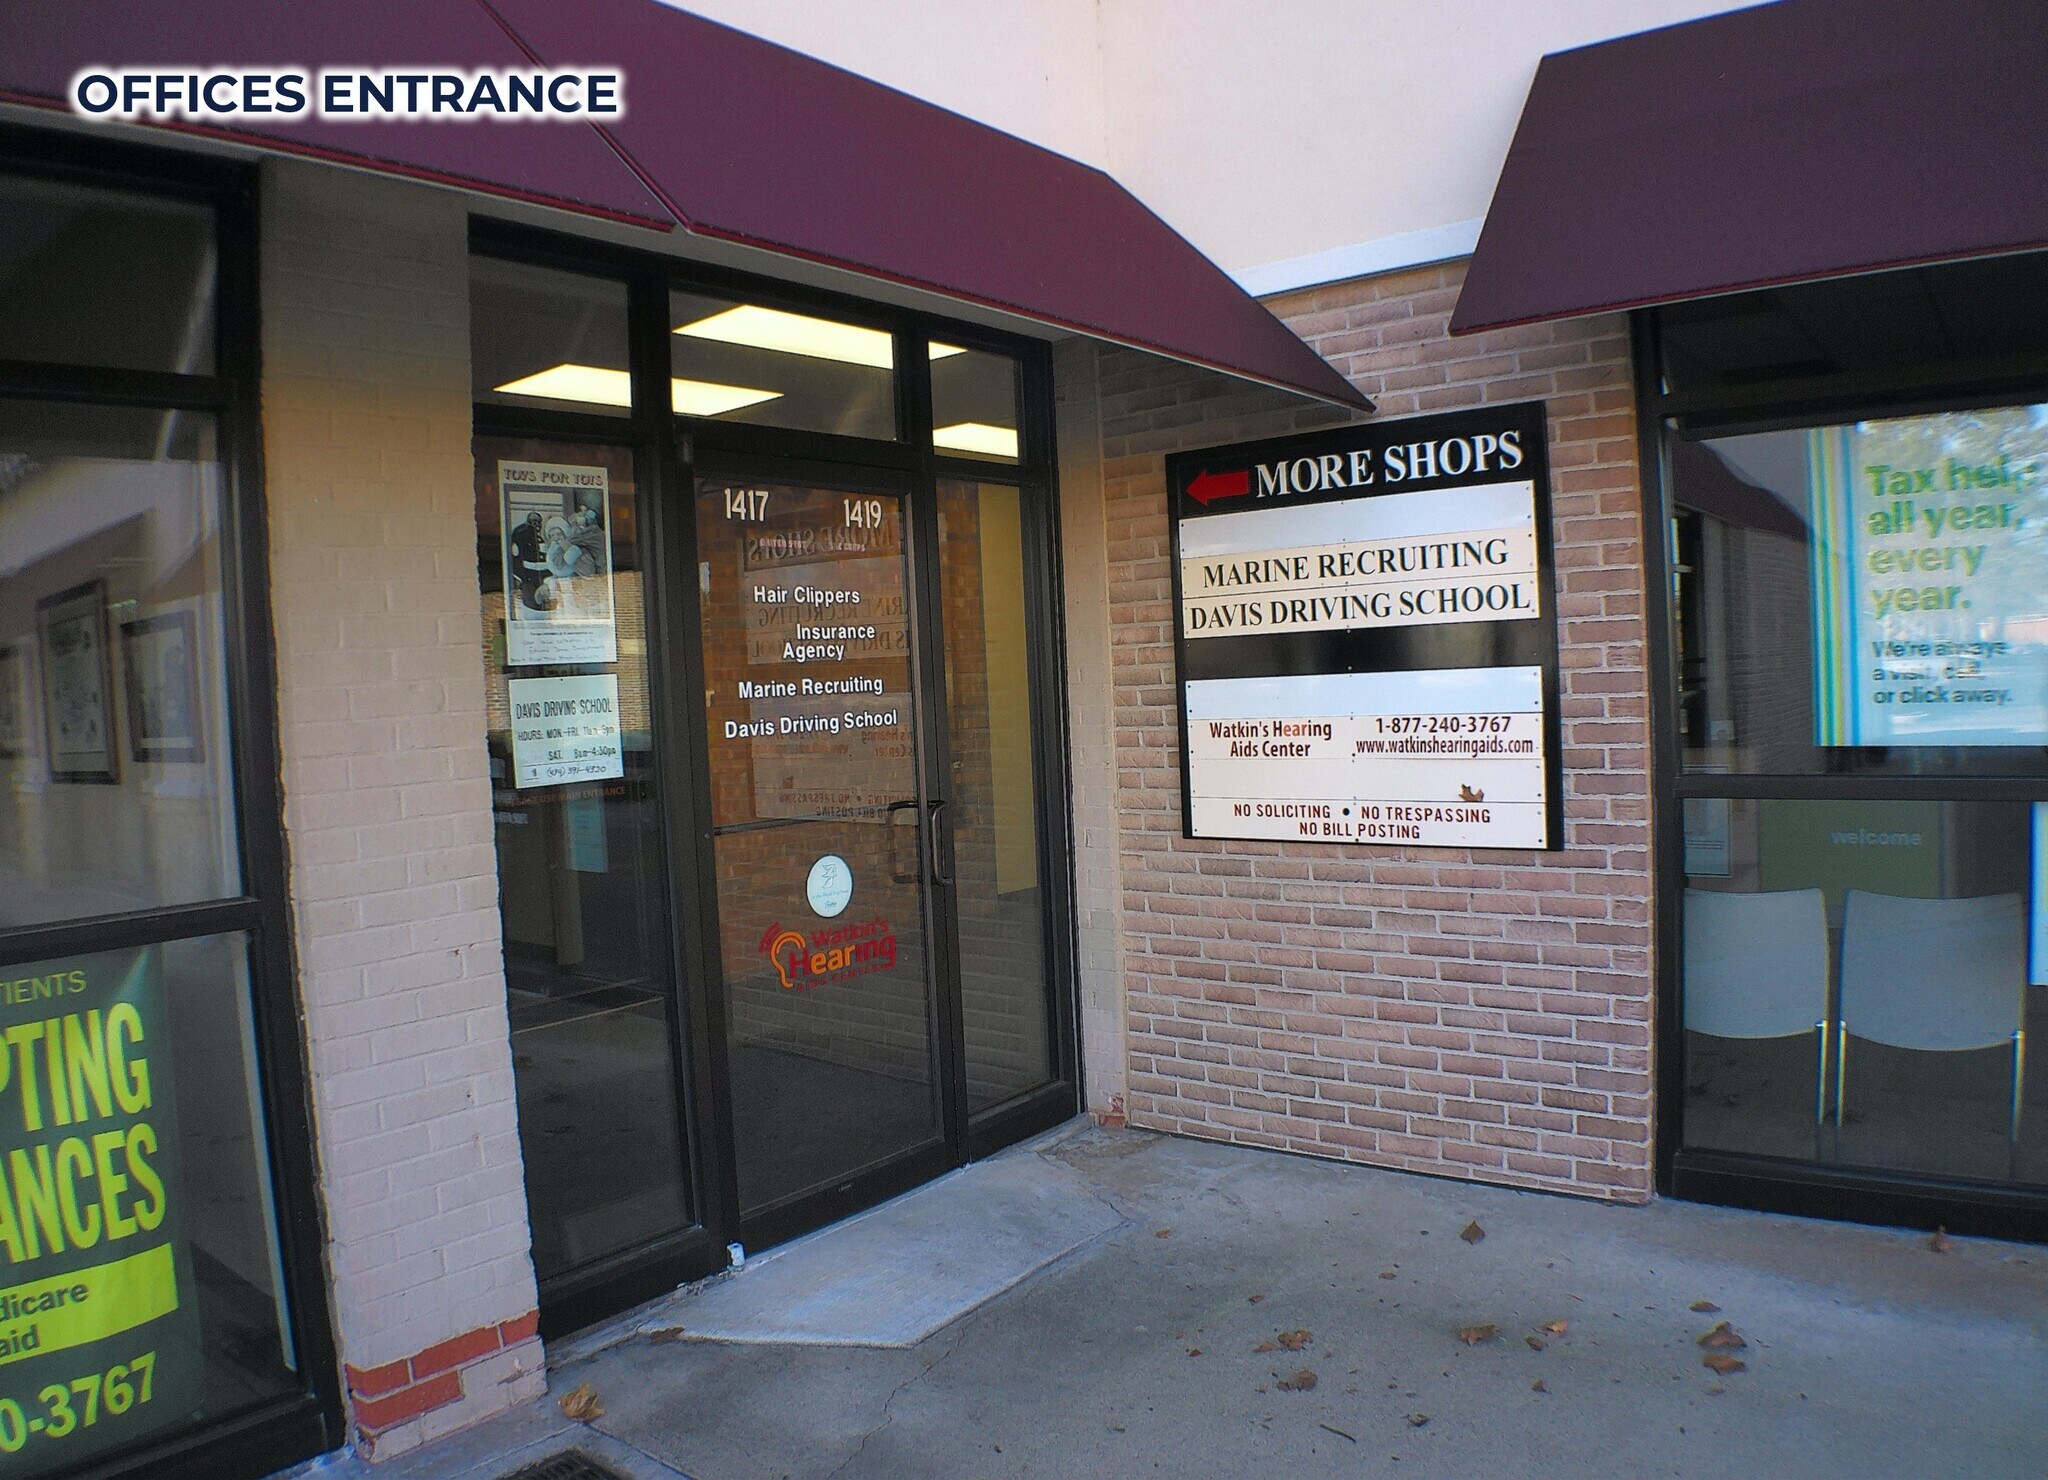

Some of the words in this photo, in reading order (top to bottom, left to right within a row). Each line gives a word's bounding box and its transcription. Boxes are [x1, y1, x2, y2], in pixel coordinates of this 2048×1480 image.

[1255, 450, 1375, 498] MORE
[1383, 430, 1525, 484] SHOPS
[1864, 464, 1937, 496] Tax
[724, 487, 769, 522] 1417
[843, 498, 882, 529] 1419
[1867, 500, 1914, 536] all
[1203, 556, 1310, 589] MARINE
[1317, 538, 1510, 579] RECRUITING
[1868, 545, 1985, 577] every
[754, 585, 789, 604] Hair
[794, 585, 863, 608] Clippers
[1190, 601, 1263, 631] DAVIS
[1270, 592, 1392, 625] DRIVING
[1399, 583, 1531, 616] SCHOOL
[1869, 586, 1972, 620] year.
[796, 623, 876, 641] Insurance
[782, 642, 845, 663] Agency
[1872, 668, 1885, 681] a
[738, 680, 797, 699] Marine
[801, 676, 884, 696] Recruiting
[1873, 690, 1895, 704] or
[1898, 685, 1949, 704] click
[1952, 689, 2013, 705] away.
[516, 702, 541, 719] DAVIS
[544, 700, 576, 717] DRIVING
[580, 698, 612, 714] SCHOOL
[724, 719, 775, 740] Davis
[779, 714, 840, 735] Driving
[843, 708, 898, 729] School
[1209, 720, 1269, 739] Watkin's
[1272, 720, 1332, 741] Hearing
[1375, 716, 1512, 734] 1-877-240-3767
[1230, 741, 1258, 757] Aids
[1262, 741, 1311, 757] Center
[1355, 735, 1533, 757] www.watkinshearingaids.com
[1234, 803, 1250, 817] NO
[1256, 804, 1331, 818] SOLICITING
[1361, 806, 1380, 820] NO
[1386, 807, 1491, 823] TRESPASSING
[1299, 822, 1317, 836] NO
[1323, 822, 1353, 836] BILL
[1358, 823, 1420, 838] POSTING
[1828, 829, 1923, 846] welcome
[809, 916, 889, 948] Watkin's
[788, 934, 897, 980] Hearing
